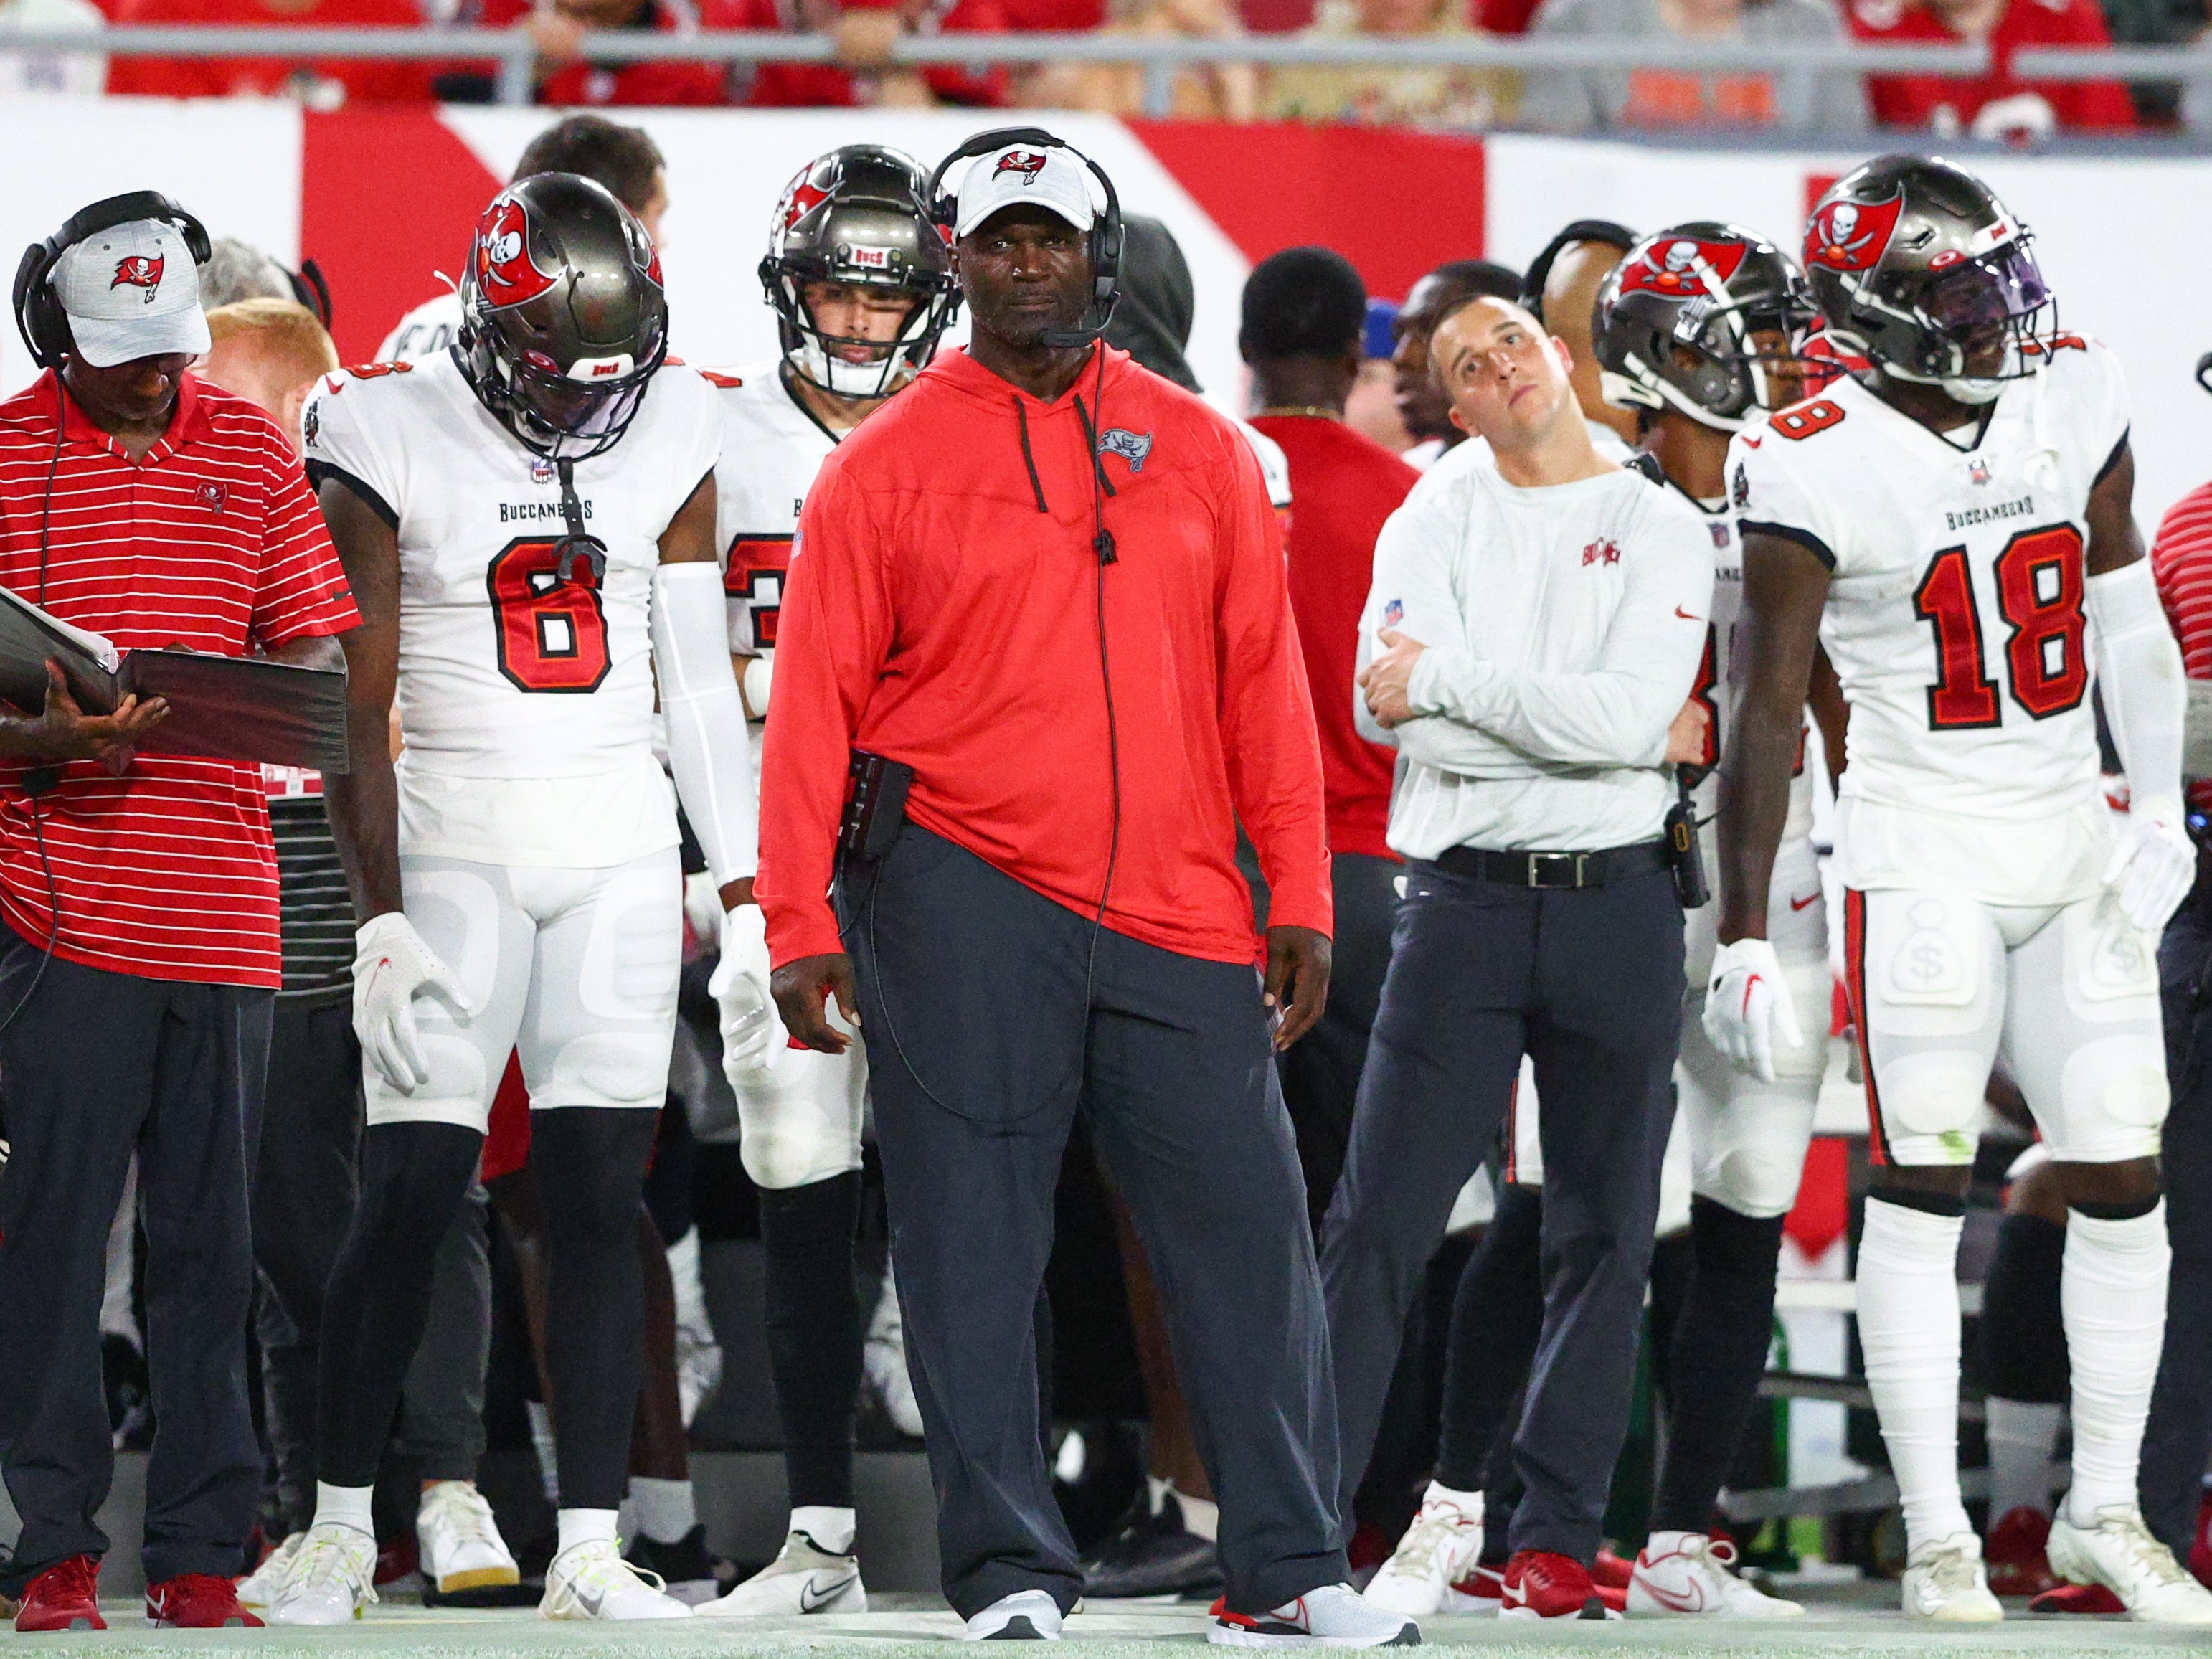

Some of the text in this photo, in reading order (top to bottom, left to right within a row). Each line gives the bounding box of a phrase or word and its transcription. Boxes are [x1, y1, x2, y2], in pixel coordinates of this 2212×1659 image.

[498, 499, 592, 523] BUCCANES
[486, 534, 613, 694] 6
[1911, 520, 2089, 732] 18
